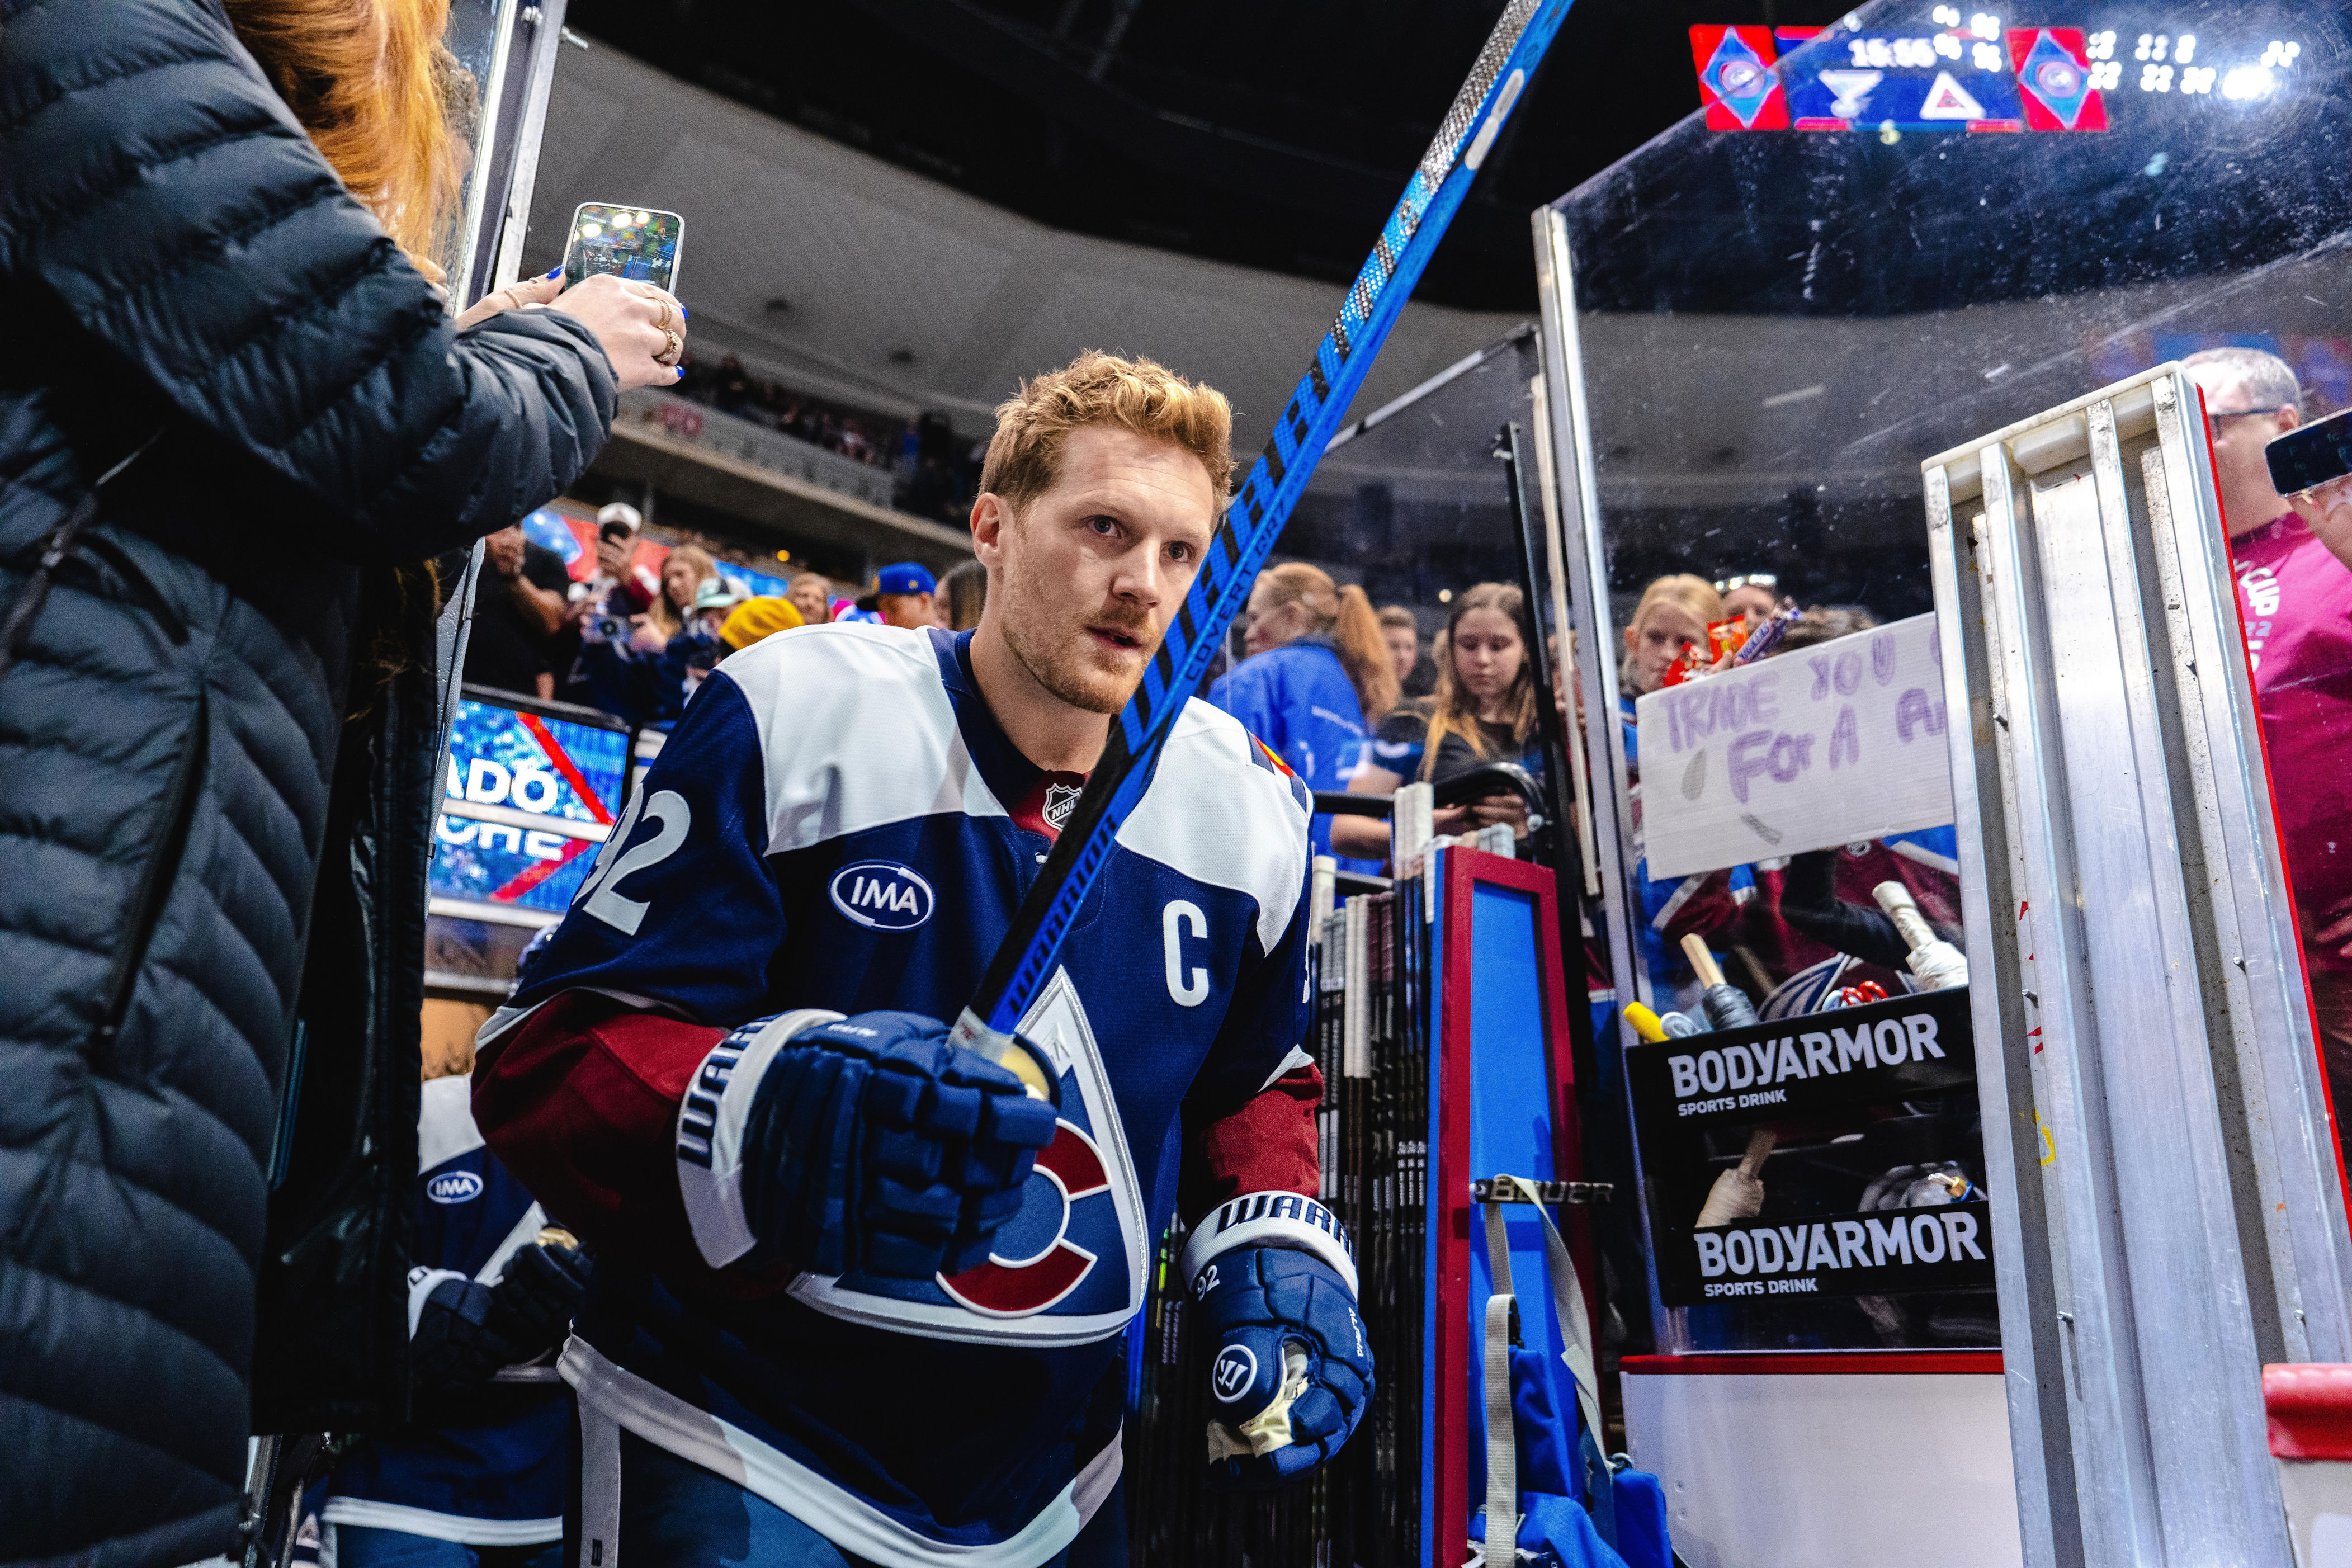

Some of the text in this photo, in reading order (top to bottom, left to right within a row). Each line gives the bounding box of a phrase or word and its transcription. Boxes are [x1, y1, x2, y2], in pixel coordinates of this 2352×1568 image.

[1186, 568, 1253, 681] COVERT
[1808, 632, 1896, 701] YOU
[1829, 703, 1859, 771] A
[851, 876, 918, 915] IMA
[1009, 815, 1116, 1016] WARRIOR
[1163, 900, 1209, 1007] C
[1668, 1013, 1946, 1098] BODYARMOR
[1678, 1089, 1787, 1117] SPORTS DRINK
[436, 1178, 475, 1197] IMA
[1693, 1212, 1986, 1277] BODYARMOR
[1197, 1265, 1220, 1301] 92
[1704, 1278, 1819, 1297] SPORTS DRINK
